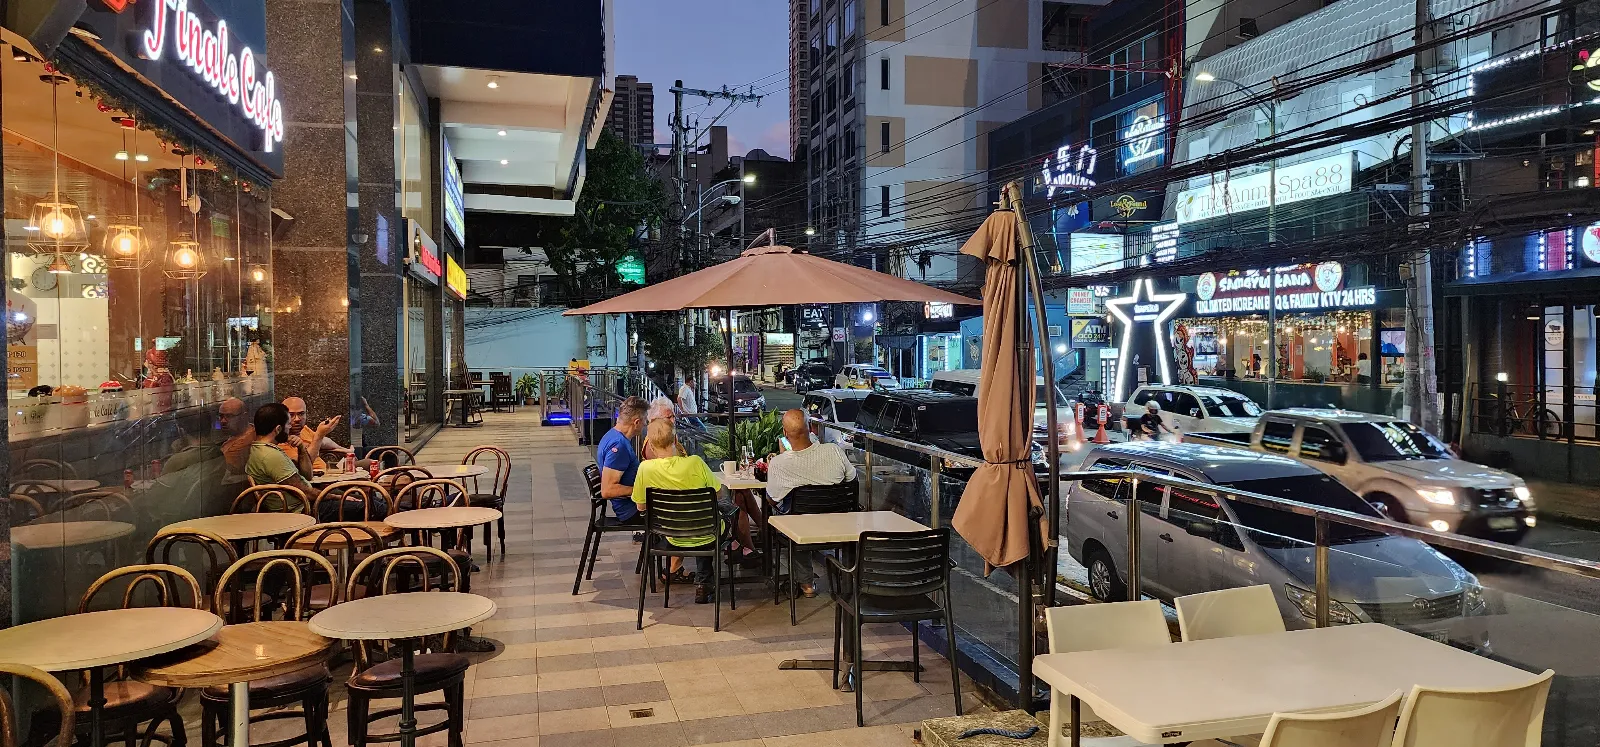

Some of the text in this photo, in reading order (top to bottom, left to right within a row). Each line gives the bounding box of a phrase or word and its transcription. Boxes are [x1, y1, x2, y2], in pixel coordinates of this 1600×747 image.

[1278, 175, 1312, 198] Spa
[1315, 164, 1342, 186] 88
[1196, 287, 1376, 314] UNLIMITED KOREAN BQ & FAMILY KTV 24 HRS
[803, 308, 825, 318] EAT
[1084, 325, 1107, 333] ATM
